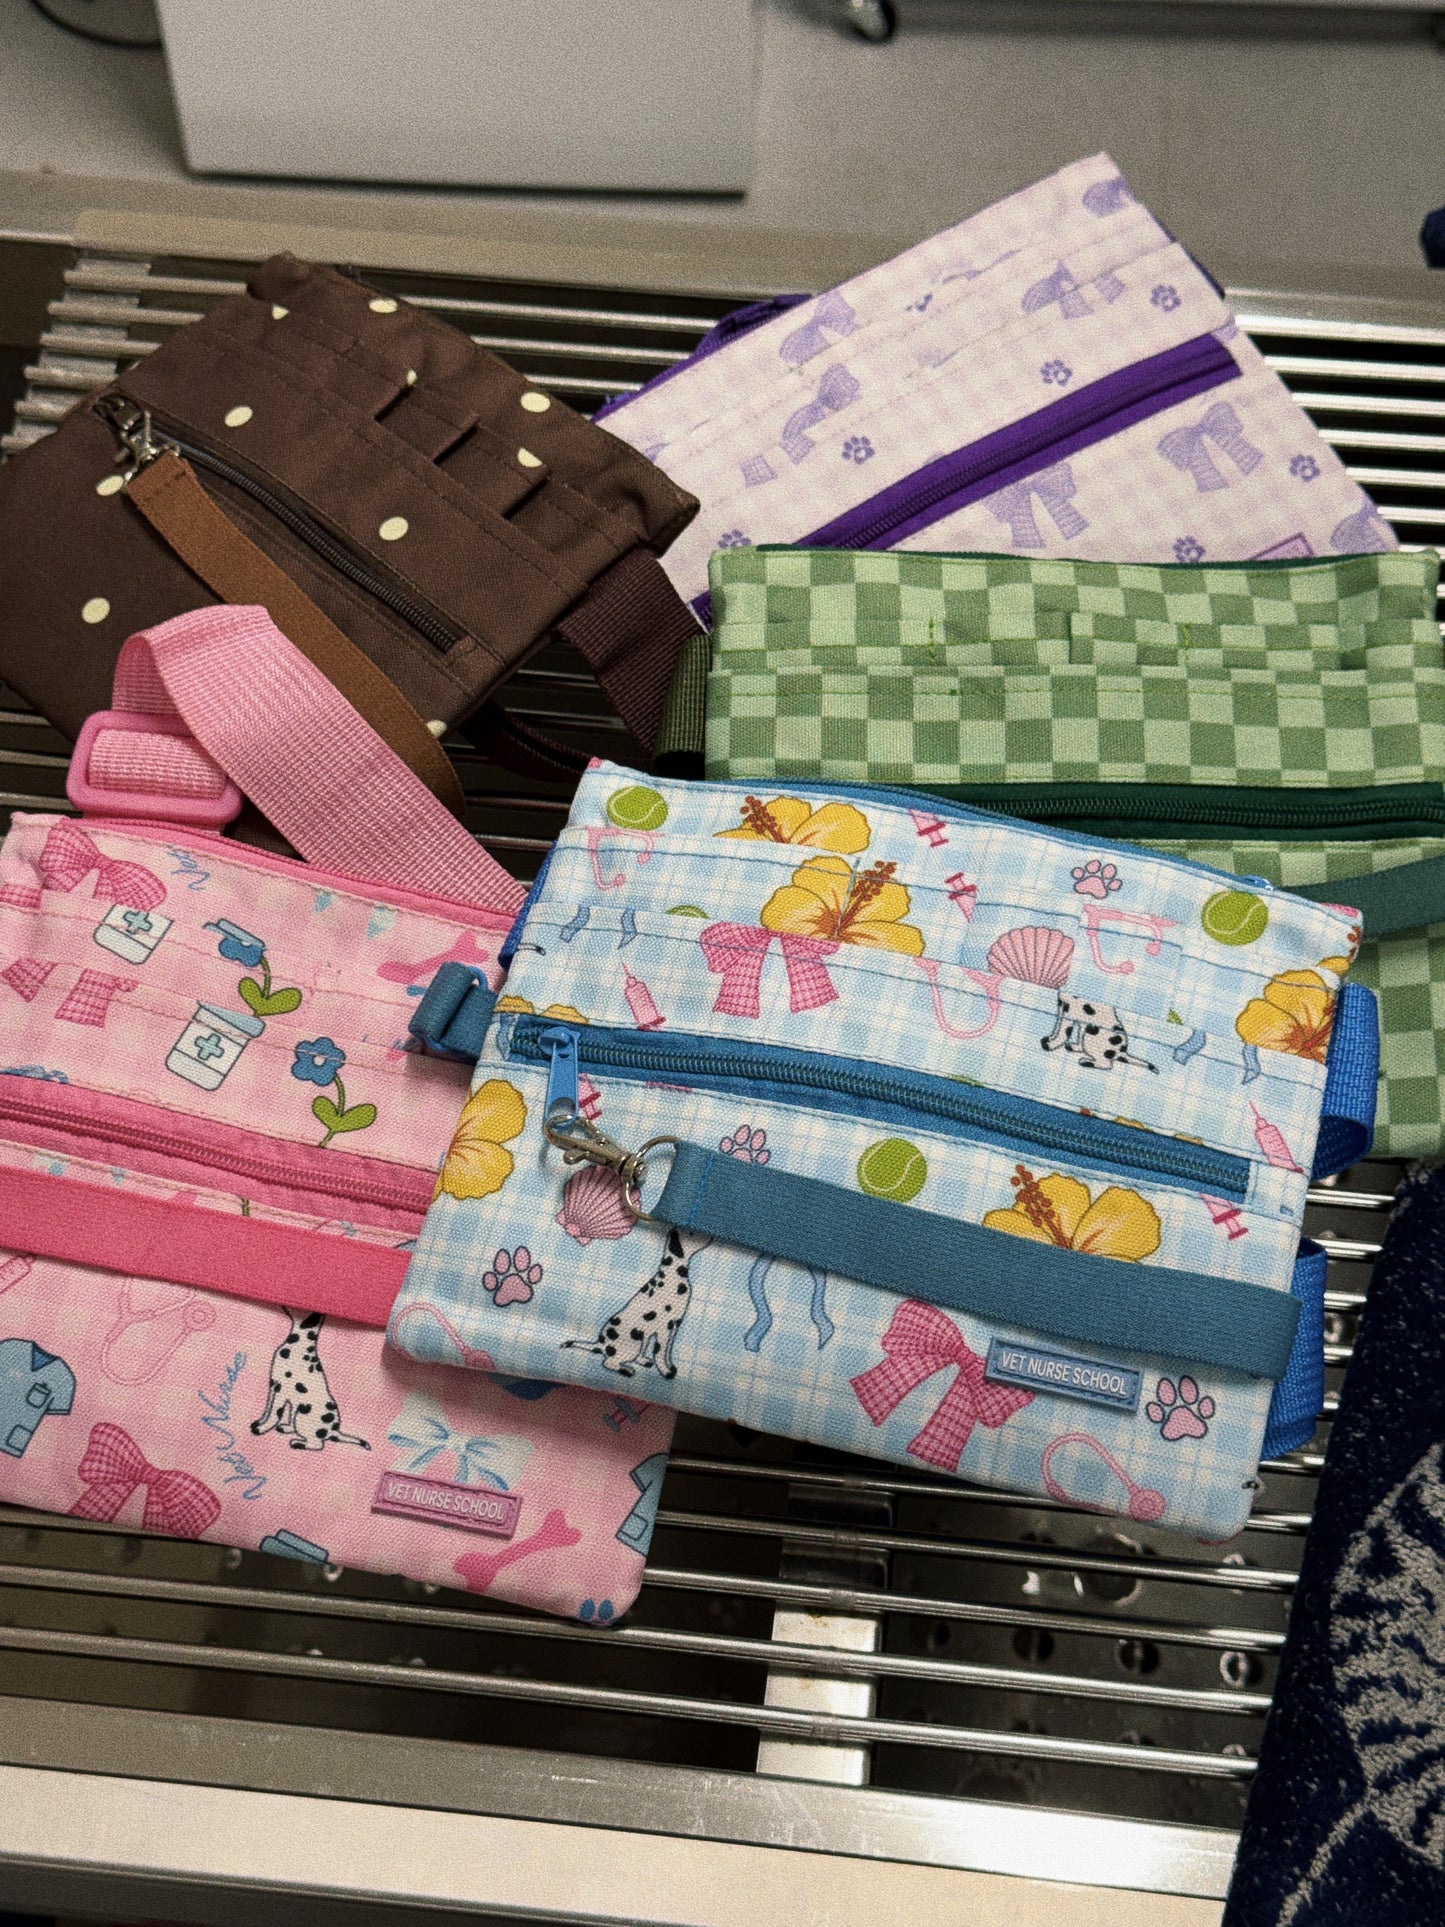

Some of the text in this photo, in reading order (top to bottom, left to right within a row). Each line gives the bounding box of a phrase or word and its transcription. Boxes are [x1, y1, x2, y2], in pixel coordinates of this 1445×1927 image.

[1002, 1351, 1127, 1396] VET NURSE SCHOOL
[387, 1482, 504, 1521] VET NURSE SCHOOL
